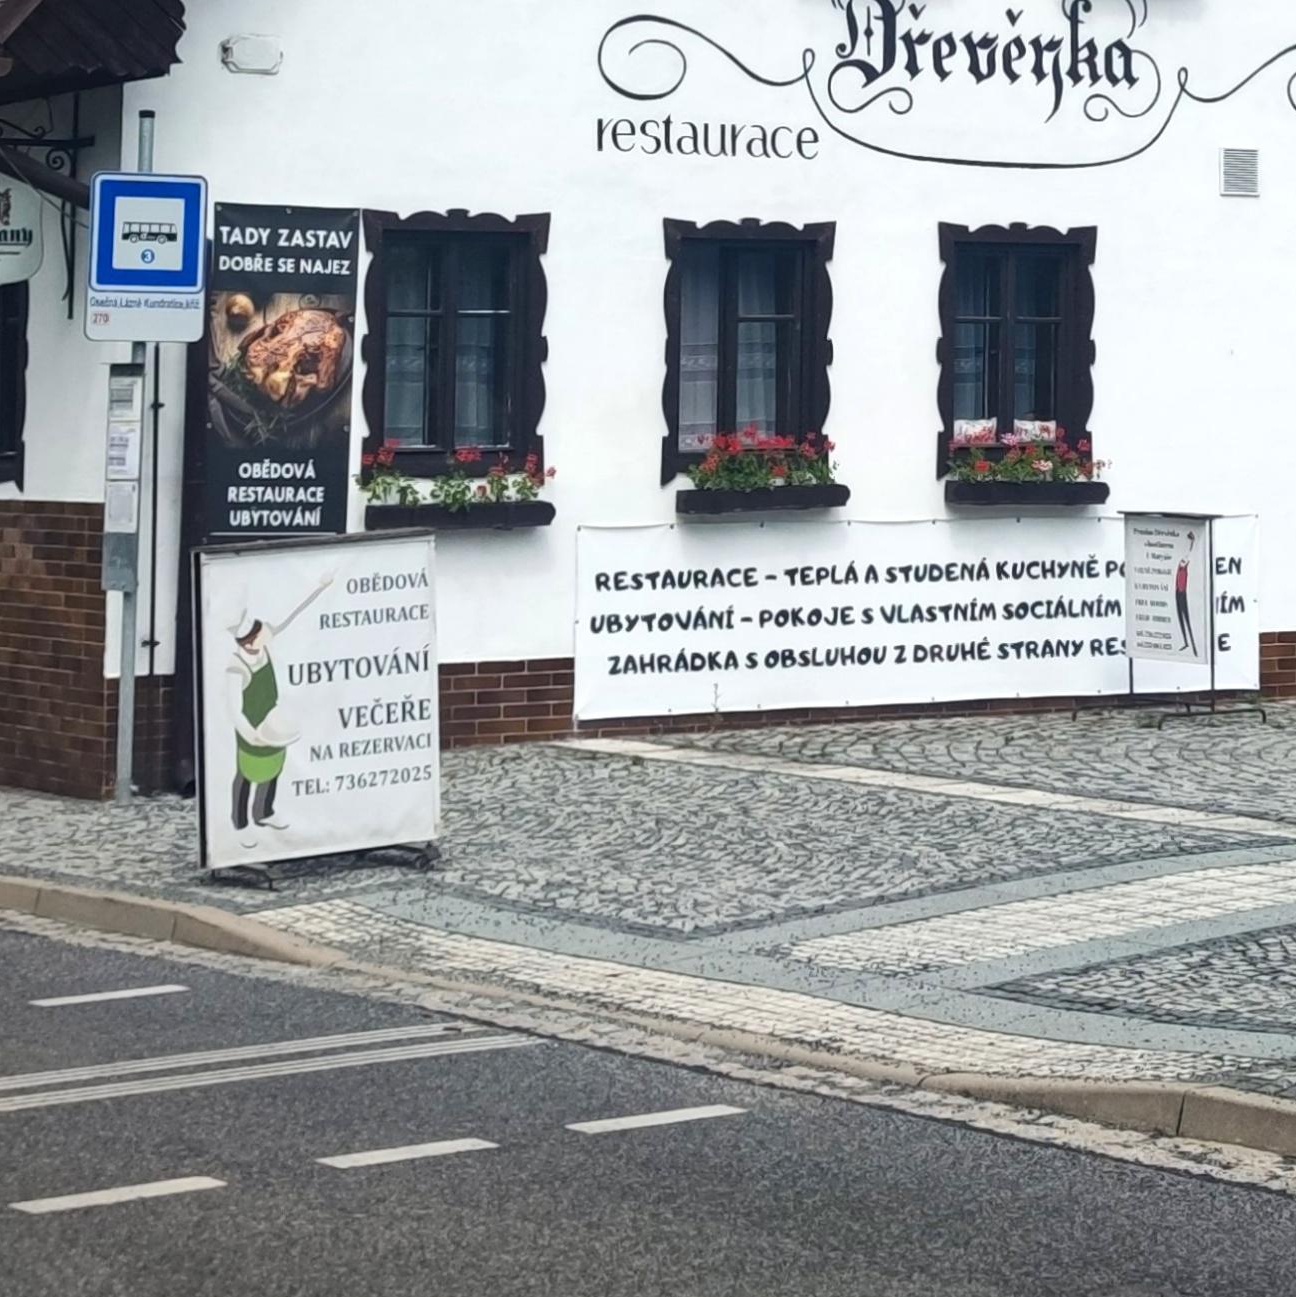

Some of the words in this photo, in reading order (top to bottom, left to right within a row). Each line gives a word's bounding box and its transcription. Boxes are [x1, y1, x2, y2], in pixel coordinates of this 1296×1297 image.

[596, 113, 820, 161] restaurace
[219, 226, 271, 245] TADY
[277, 228, 353, 249] ZASTAV
[218, 253, 273, 272] DOBŘE
[277, 258, 295, 273] SE
[299, 258, 351, 275] NAJEZ
[238, 458, 316, 479] OBĚDOVÁ
[227, 486, 325, 503] RESTAURACE
[229, 506, 322, 526] UBYTOVÁNÍ
[346, 568, 429, 595] OBĚDOVÁ
[595, 567, 759, 592] RESTAURACE
[784, 561, 859, 587] TEPLÁ
[864, 564, 879, 584] A
[885, 558, 990, 584] STUDENÁ
[996, 554, 1100, 581] KUCHYNĚ
[319, 604, 429, 630] RESTAURACE
[590, 604, 734, 634] UBYTOVÁNÍ
[758, 606, 855, 629] POKOJE
[861, 608, 874, 625] S
[880, 597, 997, 624] VLASTNÍM
[1002, 595, 1122, 621] SOCIÁLNÍM
[288, 644, 431, 687] UBYTOVÁNÍ
[607, 648, 739, 675] ZAHRÁDKA
[745, 652, 758, 671] S
[764, 645, 887, 669] OBSLUHOU
[893, 645, 907, 664] Z
[912, 637, 992, 663] DRUHÉ
[997, 637, 1084, 660] STRANY
[338, 694, 432, 730] VEČEŘE
[309, 744, 334, 762] NA
[339, 733, 432, 759] REZERVACI
[292, 779, 330, 797] TEL:
[335, 764, 432, 792] 736272025
